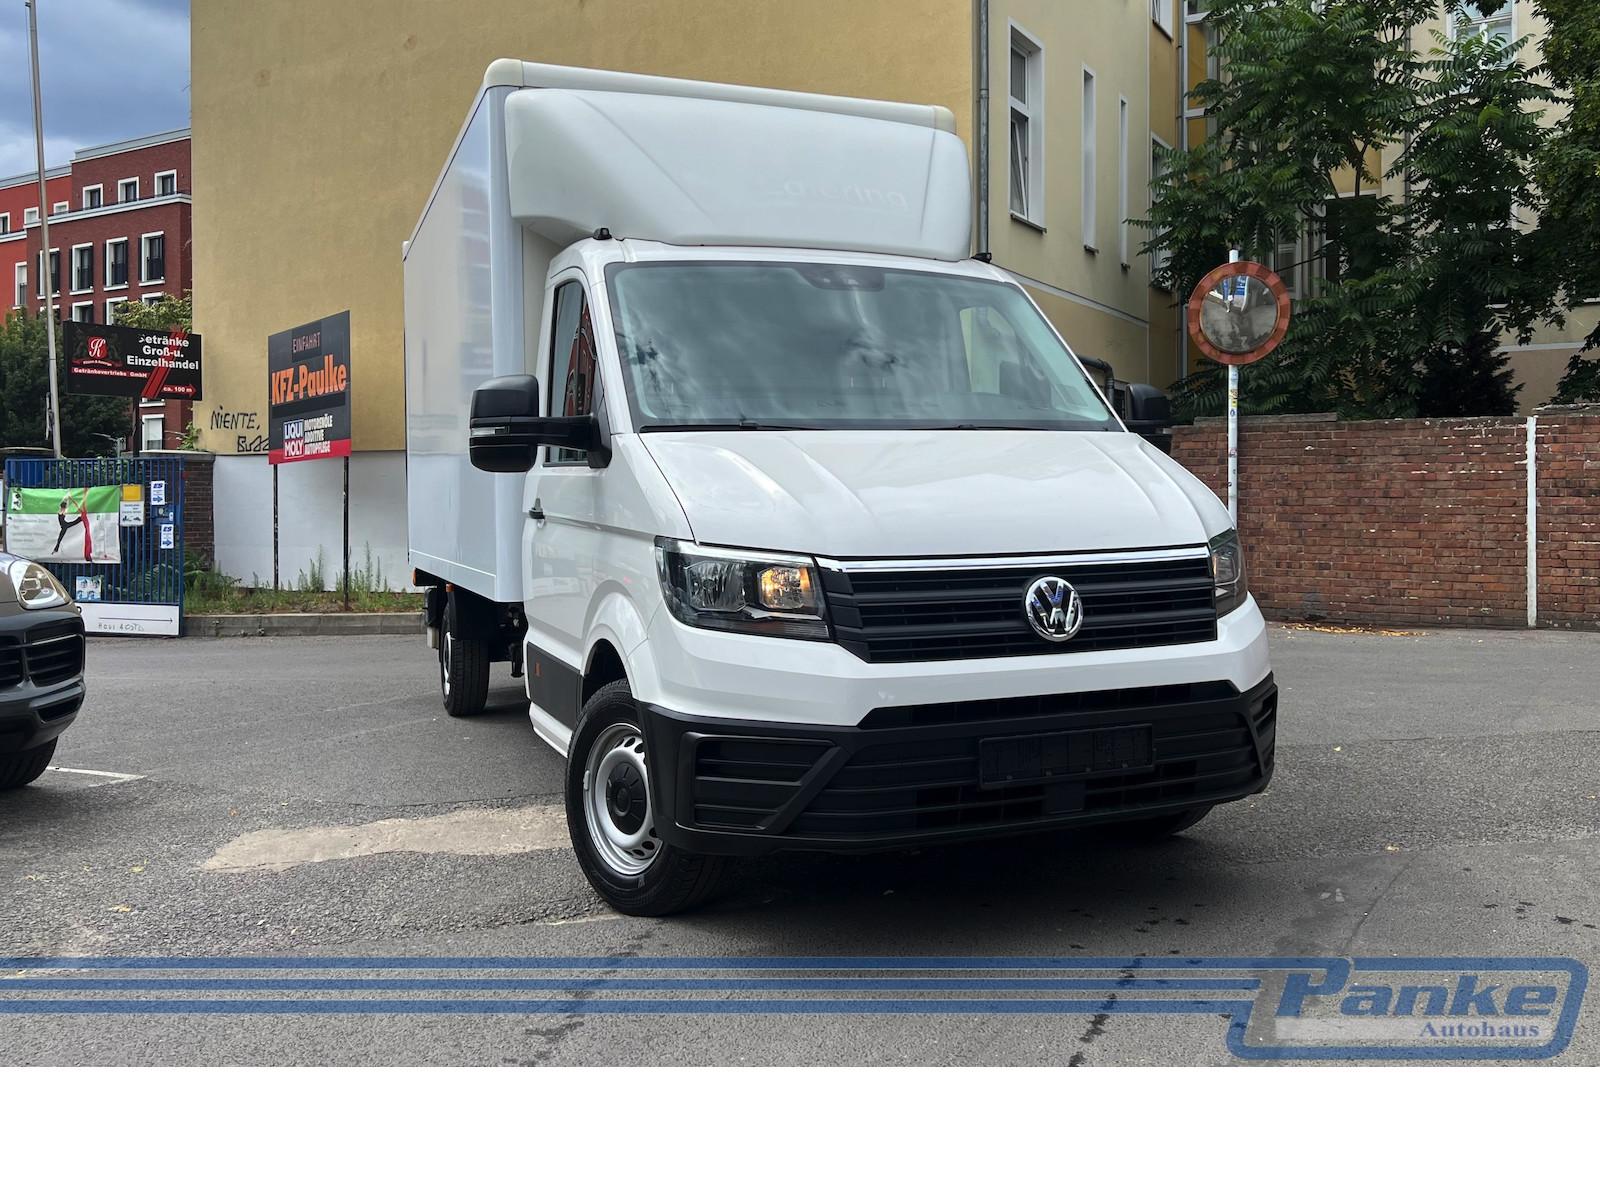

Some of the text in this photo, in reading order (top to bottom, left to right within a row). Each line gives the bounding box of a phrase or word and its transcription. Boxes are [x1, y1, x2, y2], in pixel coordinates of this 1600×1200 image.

[292, 332, 321, 353] EINFAHRT
[127, 355, 199, 370] Einzelhandel
[271, 354, 347, 405] KFZ-Paulke
[284, 420, 303, 440] LIQUI
[284, 439, 304, 457] MOLY
